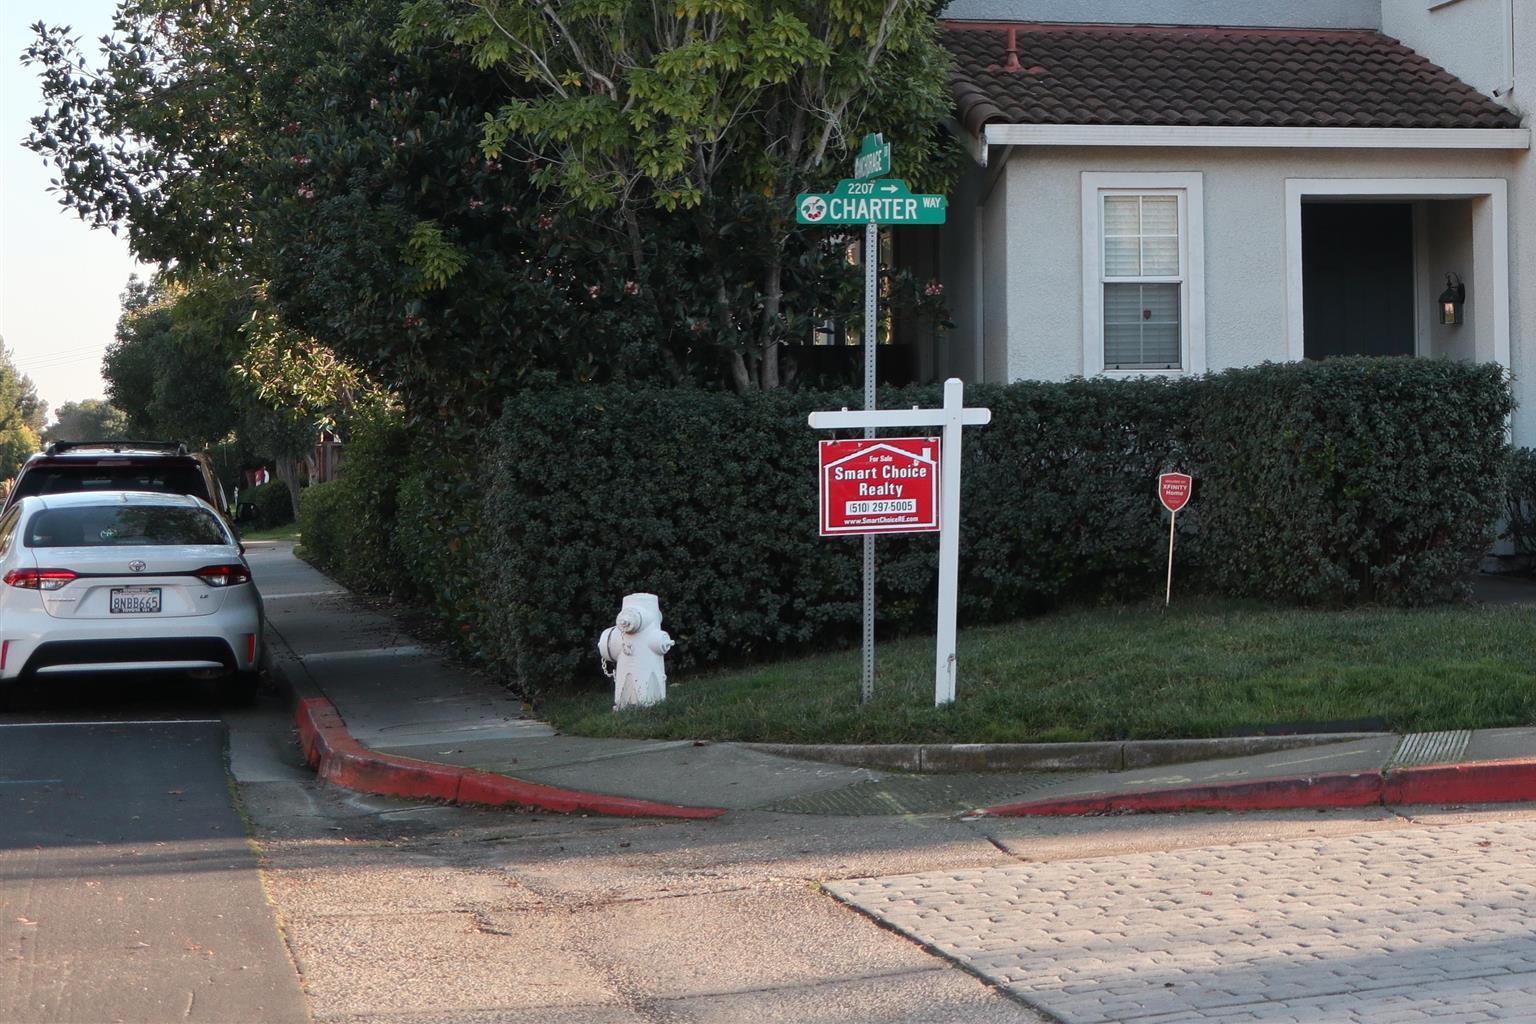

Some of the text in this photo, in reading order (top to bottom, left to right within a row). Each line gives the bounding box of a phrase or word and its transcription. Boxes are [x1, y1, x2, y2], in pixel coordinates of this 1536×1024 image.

[848, 183, 874, 194] 2207
[830, 197, 941, 219] CHARTER WAY
[835, 465, 927, 480] Smart Choice
[859, 482, 903, 497] Realty
[849, 503, 870, 513] (510)
[844, 516, 919, 525] www.SmartChoiceRE.com
